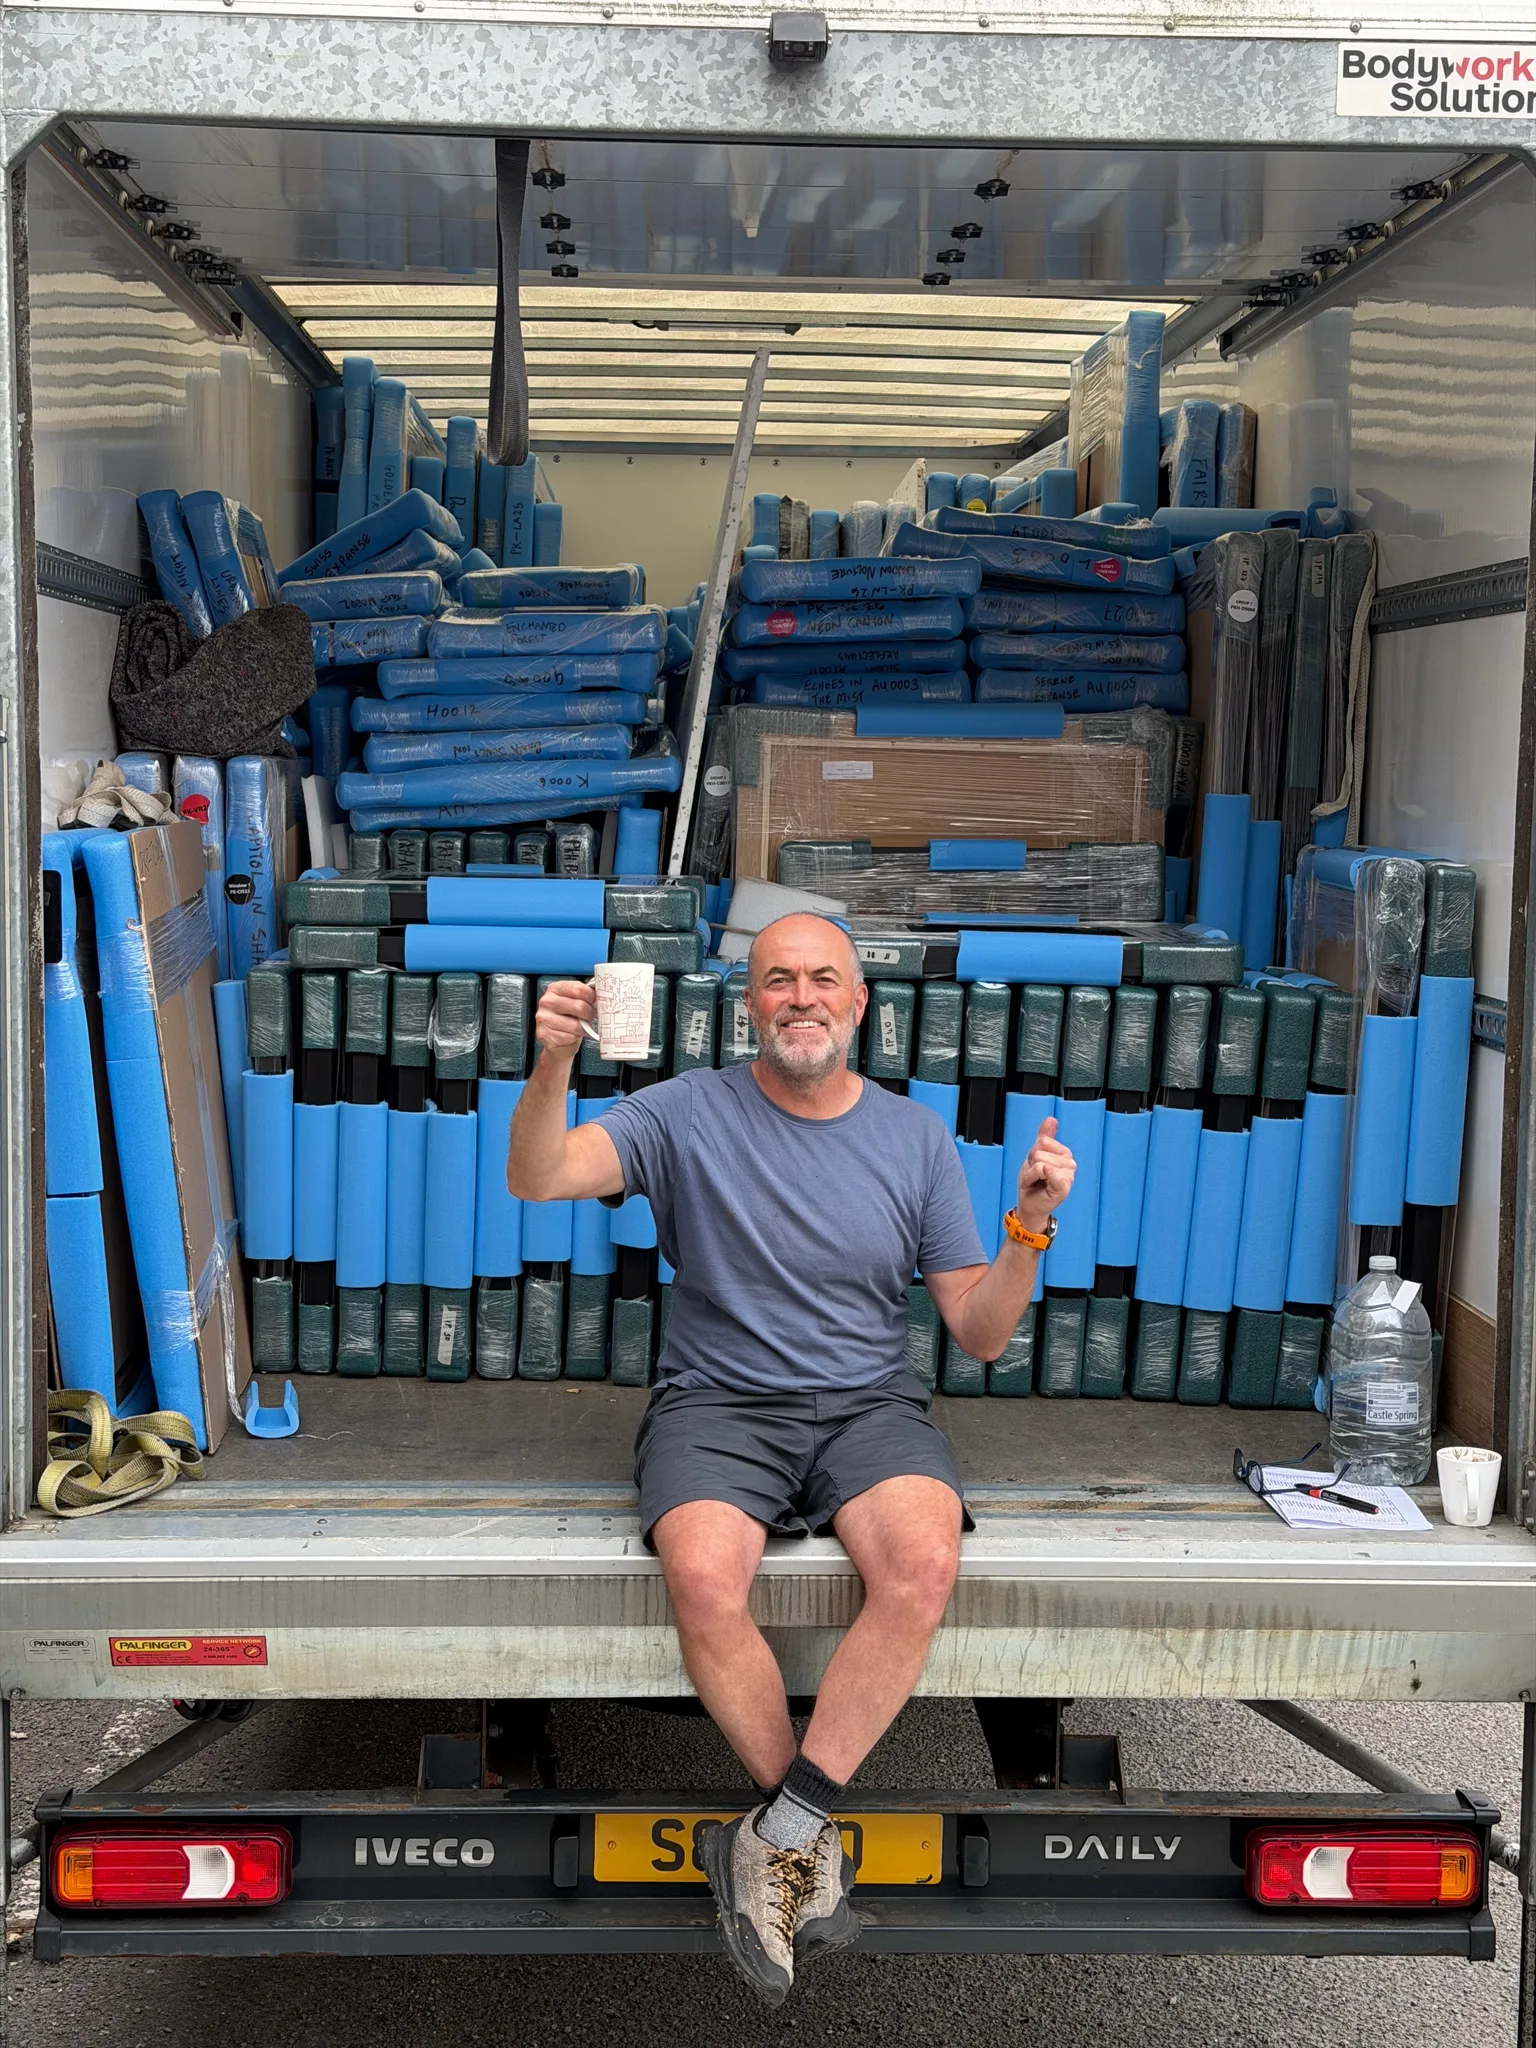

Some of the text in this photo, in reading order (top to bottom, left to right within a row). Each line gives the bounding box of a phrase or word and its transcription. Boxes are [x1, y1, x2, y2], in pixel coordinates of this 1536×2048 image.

[1342, 48, 1535, 87] Bodywork
[510, 502, 524, 555] PK-LA25
[304, 548, 333, 576] SWISS
[325, 532, 372, 578] EXPANSE
[505, 620, 567, 633] ENCHANTED
[806, 614, 842, 635] NEON
[847, 612, 895, 629] CANYON
[510, 633, 548, 645] FOREST
[803, 677, 863, 691] ECHOES IN
[1033, 675, 1076, 687] SERENE
[811, 690, 865, 706] THE MIST
[426, 703, 481, 721] H0012
[181, 804, 210, 815] PK-VR2
[251, 895, 267, 915] IN
[1368, 1409, 1393, 1420] Castle
[1394, 1410, 1417, 1422] Spring
[33, 1640, 86, 1648] PALFINGER
[119, 1640, 187, 1651] PALFINGER
[354, 1836, 496, 1868] IVECO
[1045, 1835, 1182, 1860] DAILY
